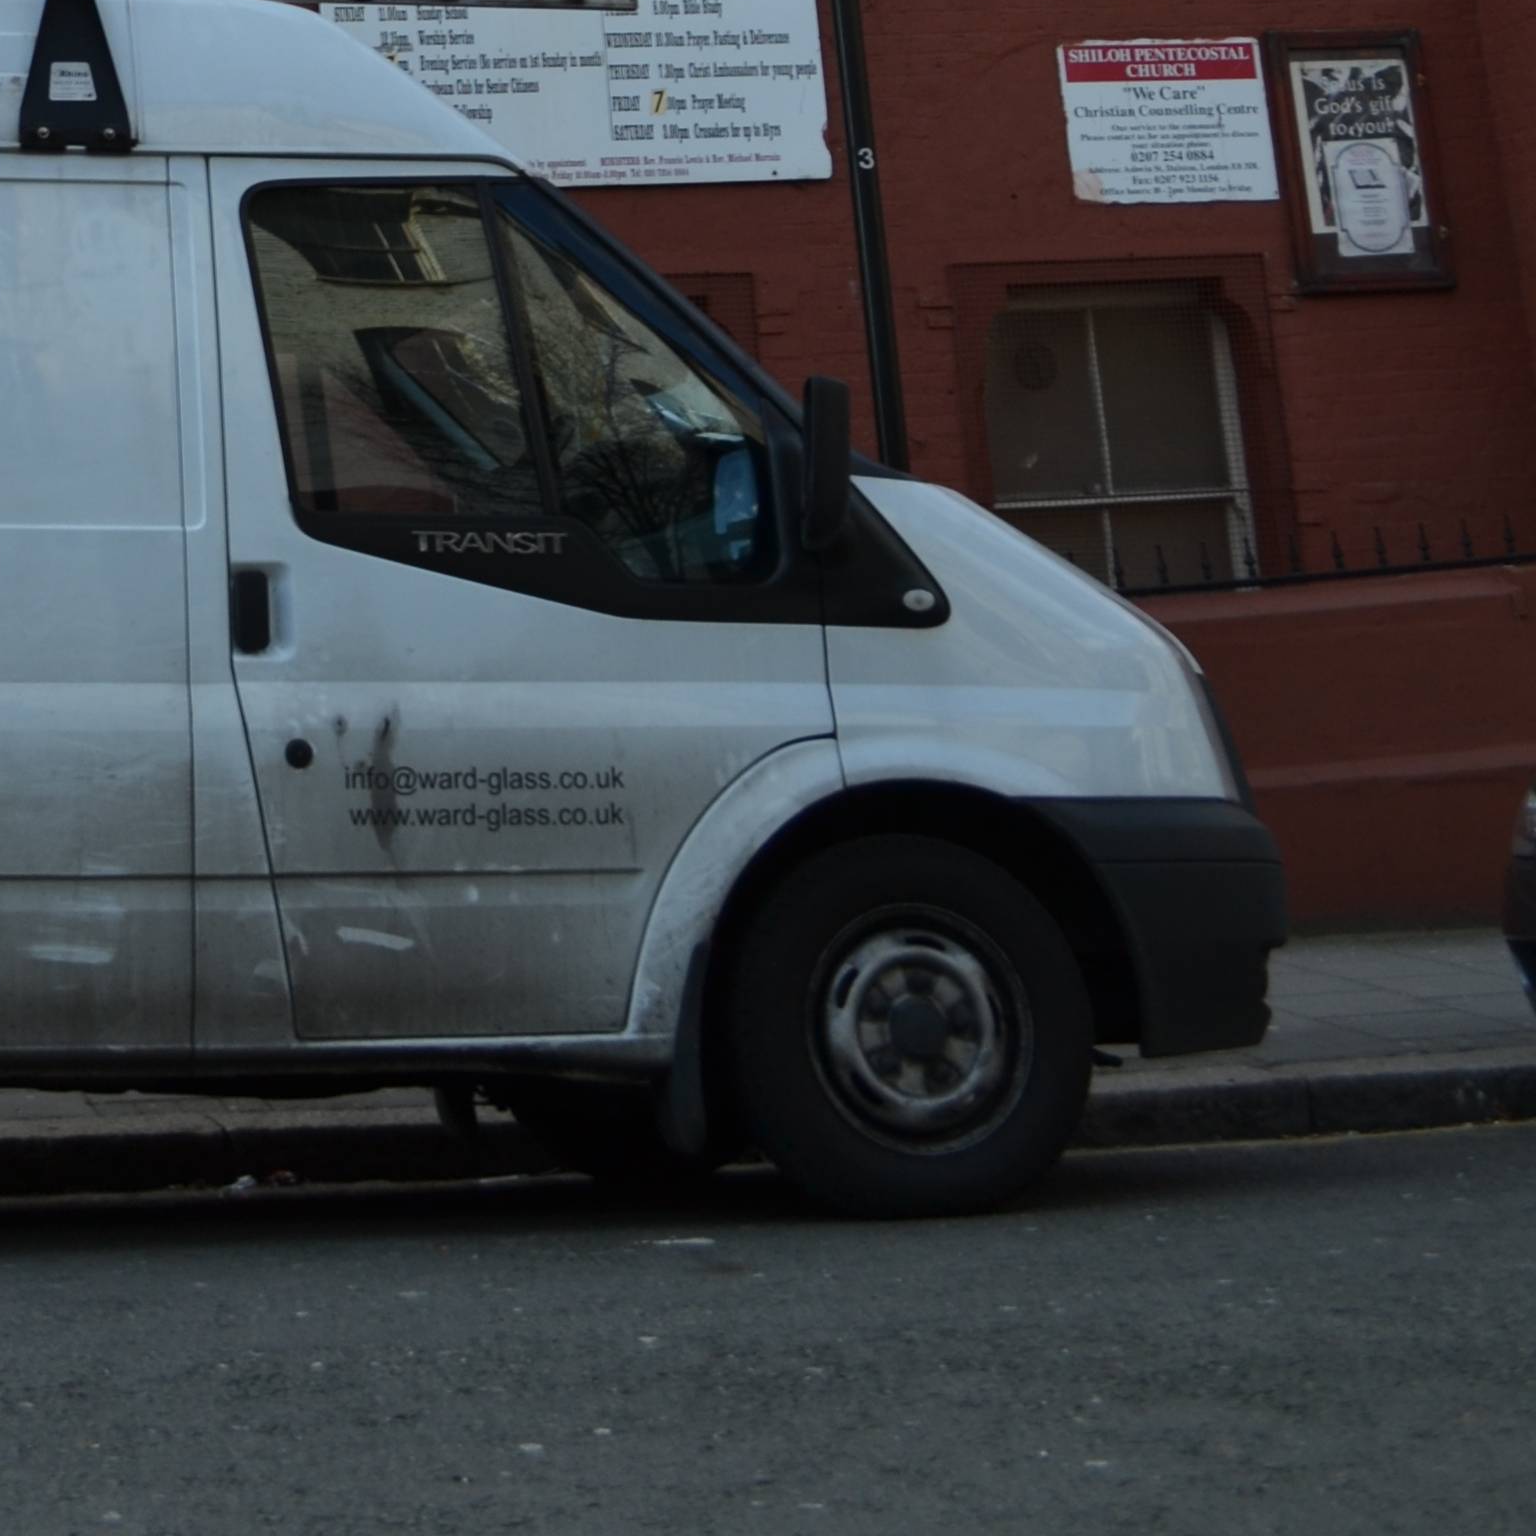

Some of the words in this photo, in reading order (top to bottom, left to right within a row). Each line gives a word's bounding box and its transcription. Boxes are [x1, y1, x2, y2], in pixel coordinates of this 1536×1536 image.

[1068, 48, 1132, 64] SHILOH
[1134, 45, 1249, 63] PENTECOSTAL
[1125, 63, 1196, 78] CHURCH
[1073, 105, 1136, 119] Christian
[1138, 102, 1215, 119] Counselling
[1216, 101, 1260, 117] Centre
[1313, 95, 1363, 115] God's
[1368, 94, 1400, 116] gif
[857, 146, 875, 170] 3
[1130, 150, 1160, 163] 0207
[1163, 149, 1184, 162] 254
[411, 530, 568, 555] TRANSIT
[343, 766, 625, 796] info@ward-glass.co.uk
[349, 801, 625, 831] www.ward-glass.co.uk
